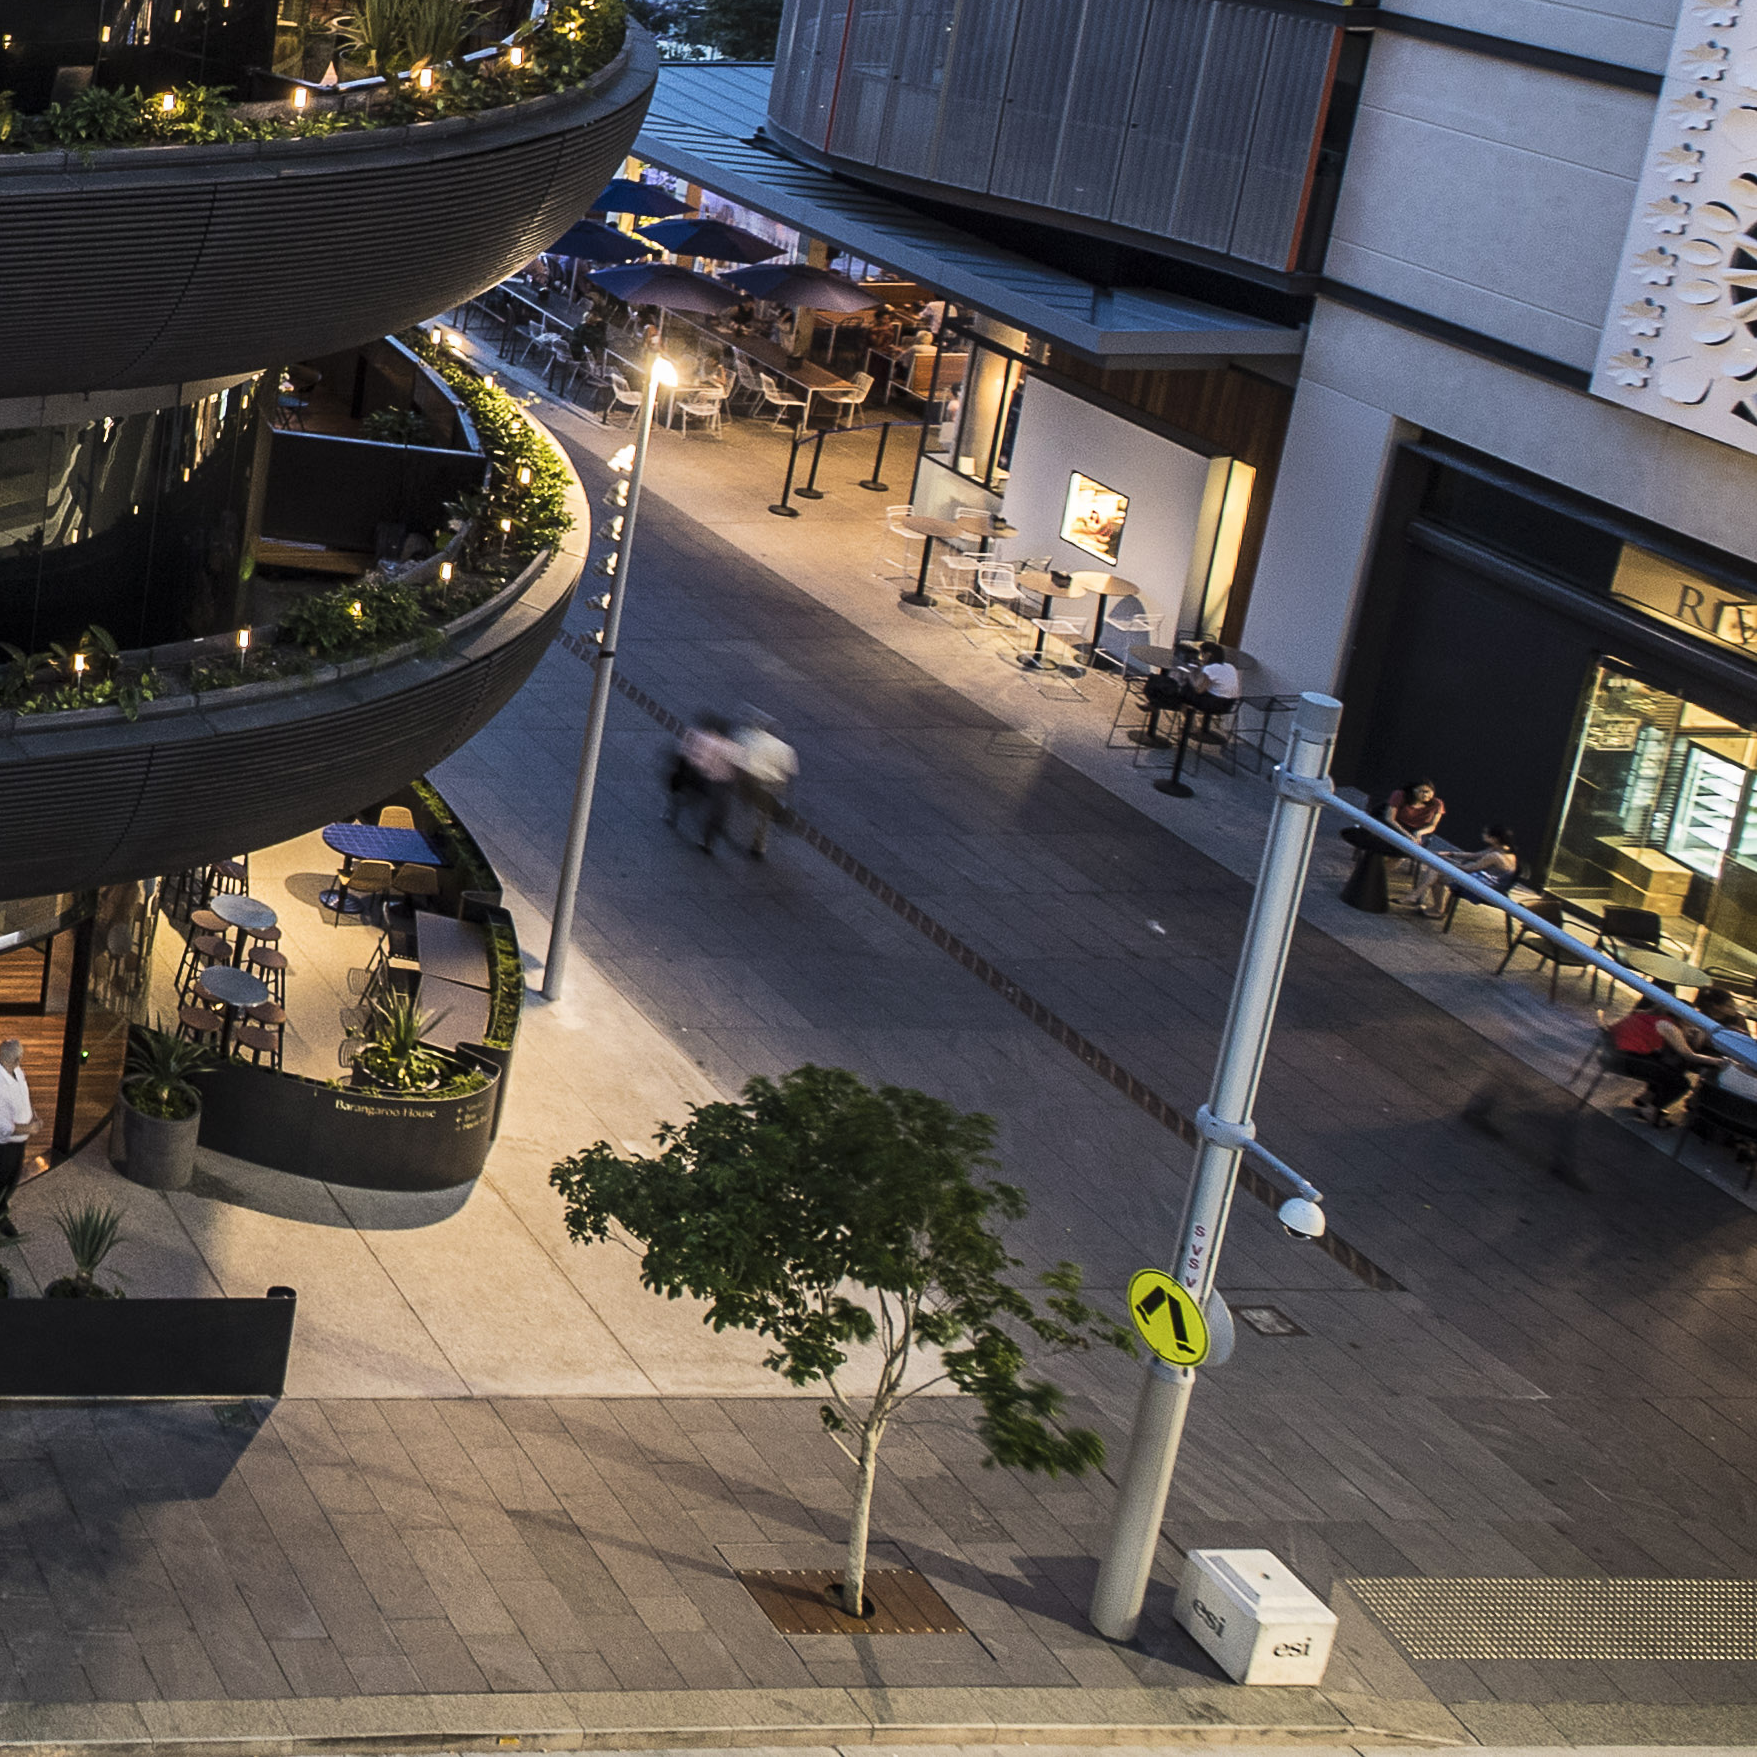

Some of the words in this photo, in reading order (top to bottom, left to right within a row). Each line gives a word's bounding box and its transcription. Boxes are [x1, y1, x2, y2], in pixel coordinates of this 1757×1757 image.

[335, 1099, 400, 1117] Barangaroo
[403, 1108, 437, 1118] House
[1192, 1598, 1227, 1638] esi
[1272, 1636, 1312, 1658] esi
